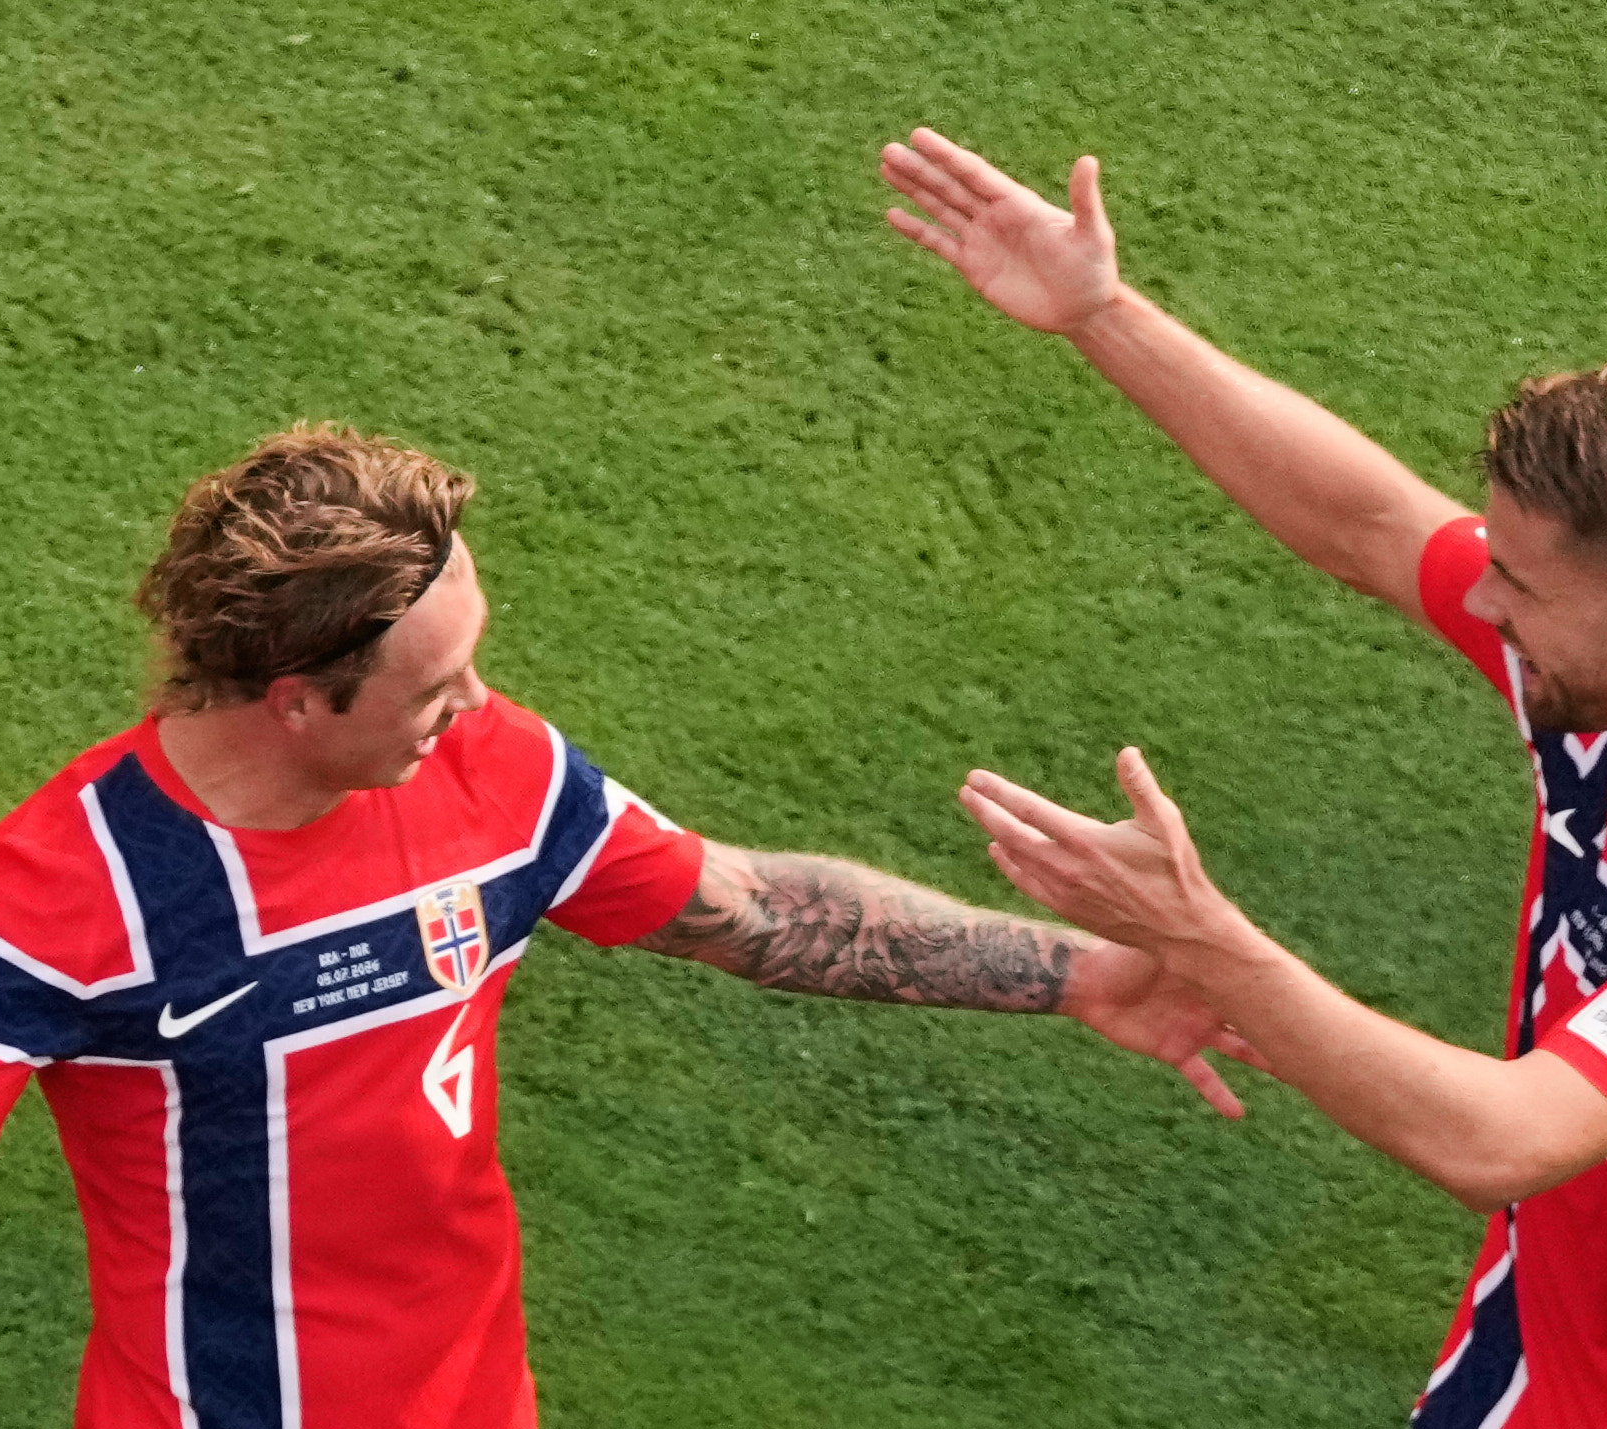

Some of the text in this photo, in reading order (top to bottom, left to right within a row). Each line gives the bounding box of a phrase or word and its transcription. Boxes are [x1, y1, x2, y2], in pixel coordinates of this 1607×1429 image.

[293, 971, 409, 1015] NEW YORK NEW JERSEY
[316, 959, 381, 987] 05.07.2026
[421, 1002, 475, 1139] 6
